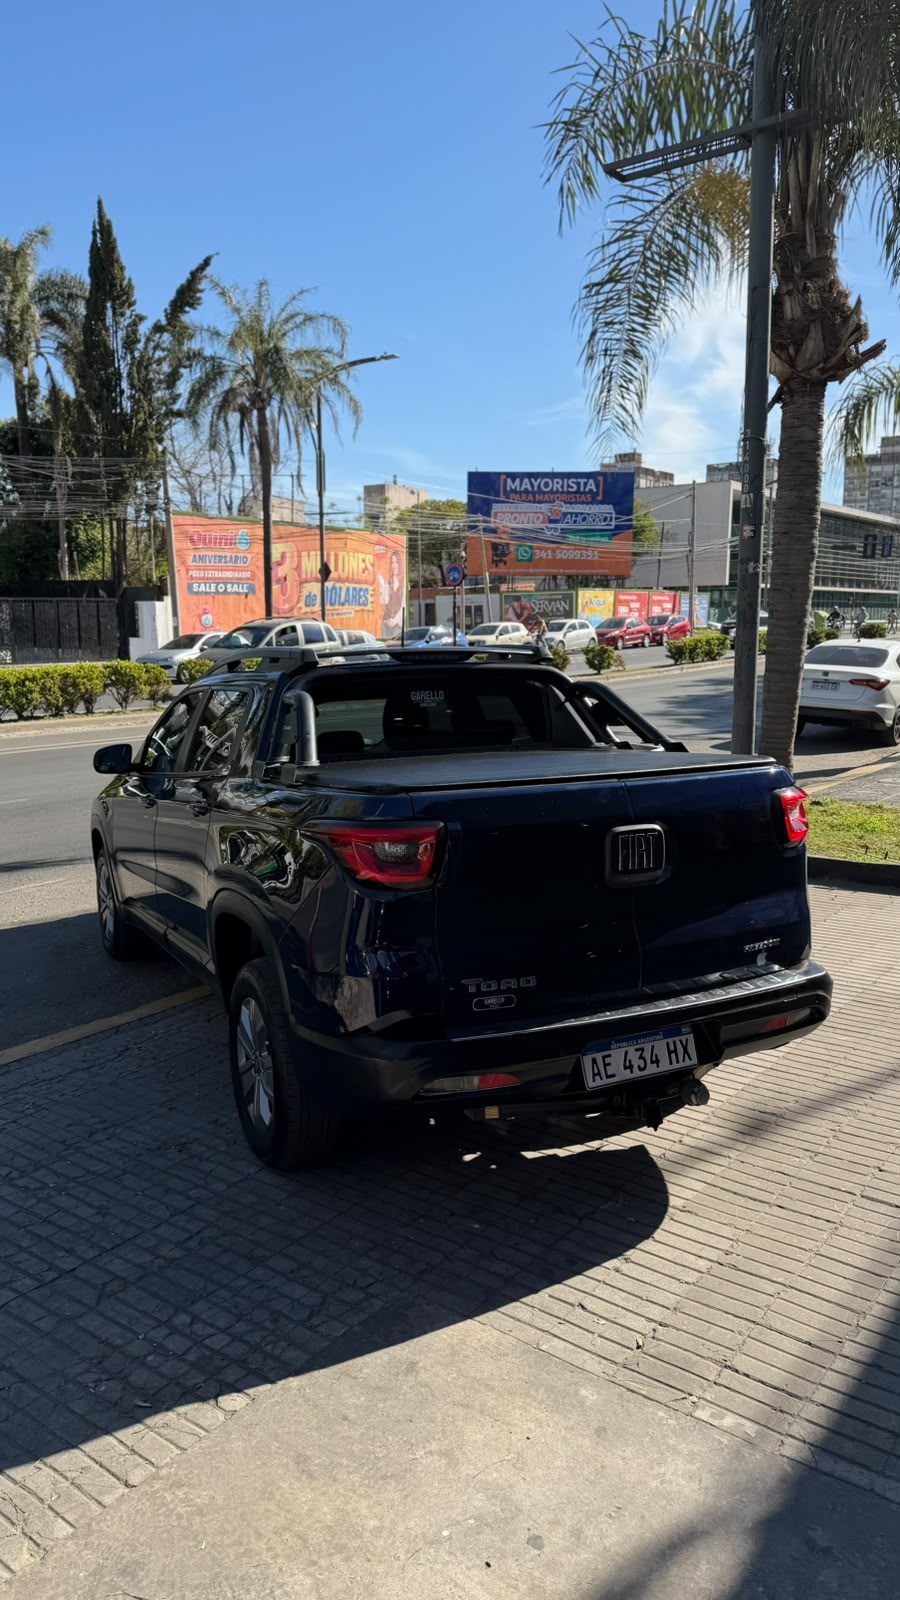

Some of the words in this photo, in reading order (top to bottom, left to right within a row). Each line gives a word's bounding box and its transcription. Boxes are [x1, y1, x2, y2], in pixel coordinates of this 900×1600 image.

[506, 478, 597, 492] MAYORISTA
[510, 493, 534, 501] PARA
[535, 493, 592, 502] MAYORISTAS
[496, 512, 543, 524] PRONTO
[564, 513, 610, 525] AHORRO
[191, 553, 248, 565] ANIVERSARIO
[534, 549, 551, 559] 341
[555, 549, 600, 560] 5099351
[189, 570, 204, 578] POZO
[205, 570, 251, 579] EXTRAORDINARIO
[270, 543, 299, 613] 3
[301, 551, 374, 578] MILONES
[192, 583, 216, 592] SALE
[218, 584, 225, 592] O
[226, 584, 249, 593] SALE
[304, 592, 317, 607] de
[410, 690, 444, 700] GARELLO
[618, 832, 659, 870] FIAT
[460, 976, 537, 993] TORO
[590, 1053, 617, 1083] AE
[622, 1044, 661, 1075] 434
[665, 1037, 694, 1066] HX
